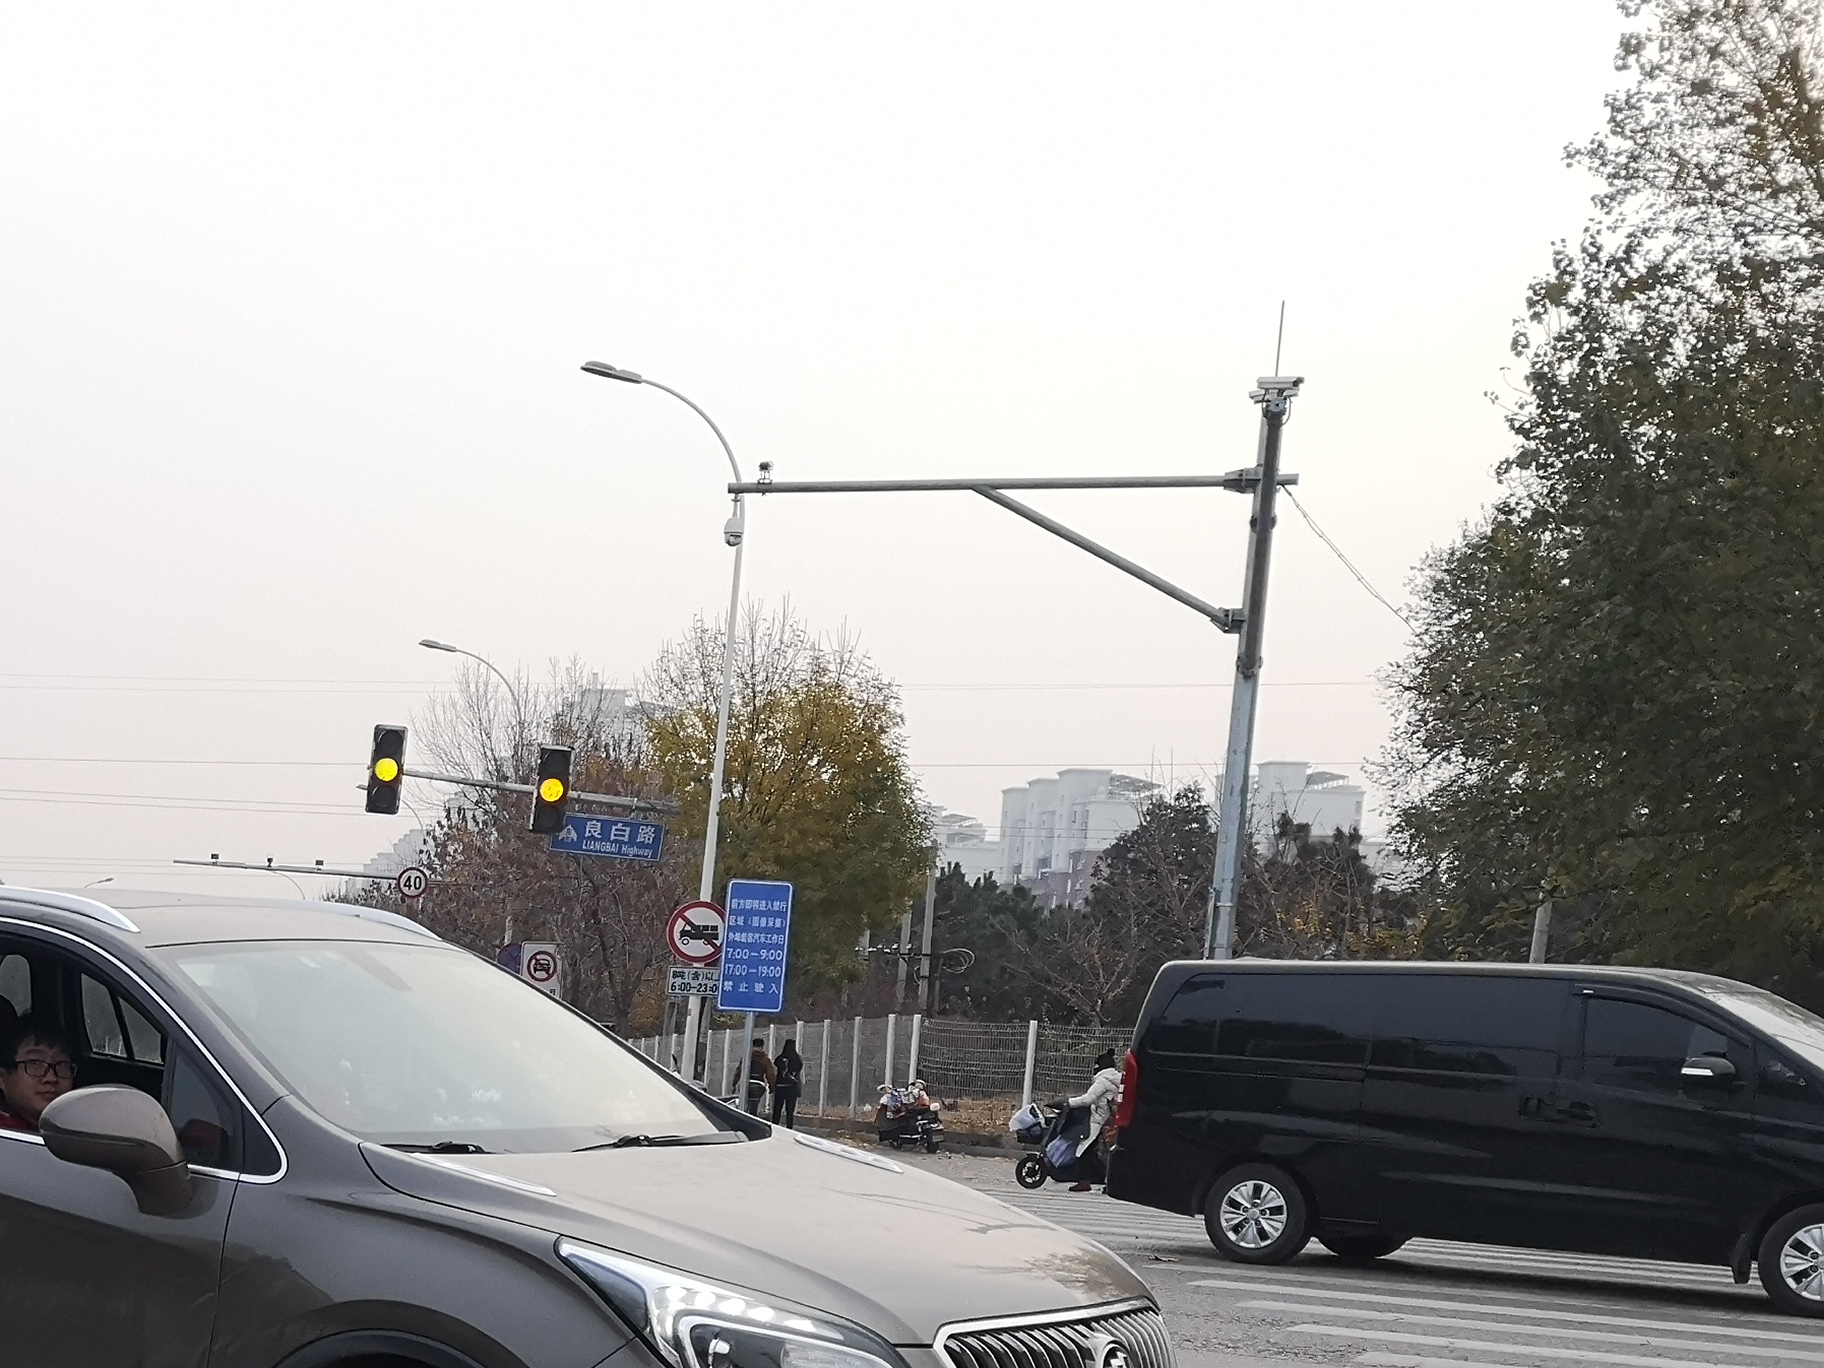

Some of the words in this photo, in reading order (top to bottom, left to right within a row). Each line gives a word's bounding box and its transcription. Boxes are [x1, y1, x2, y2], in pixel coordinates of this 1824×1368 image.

[584, 820, 656, 845] 良白路
[582, 840, 619, 853] LIANGBAI
[621, 844, 654, 858] Highway
[403, 875, 422, 891] 40
[723, 980, 779, 994] 禁止驶入
